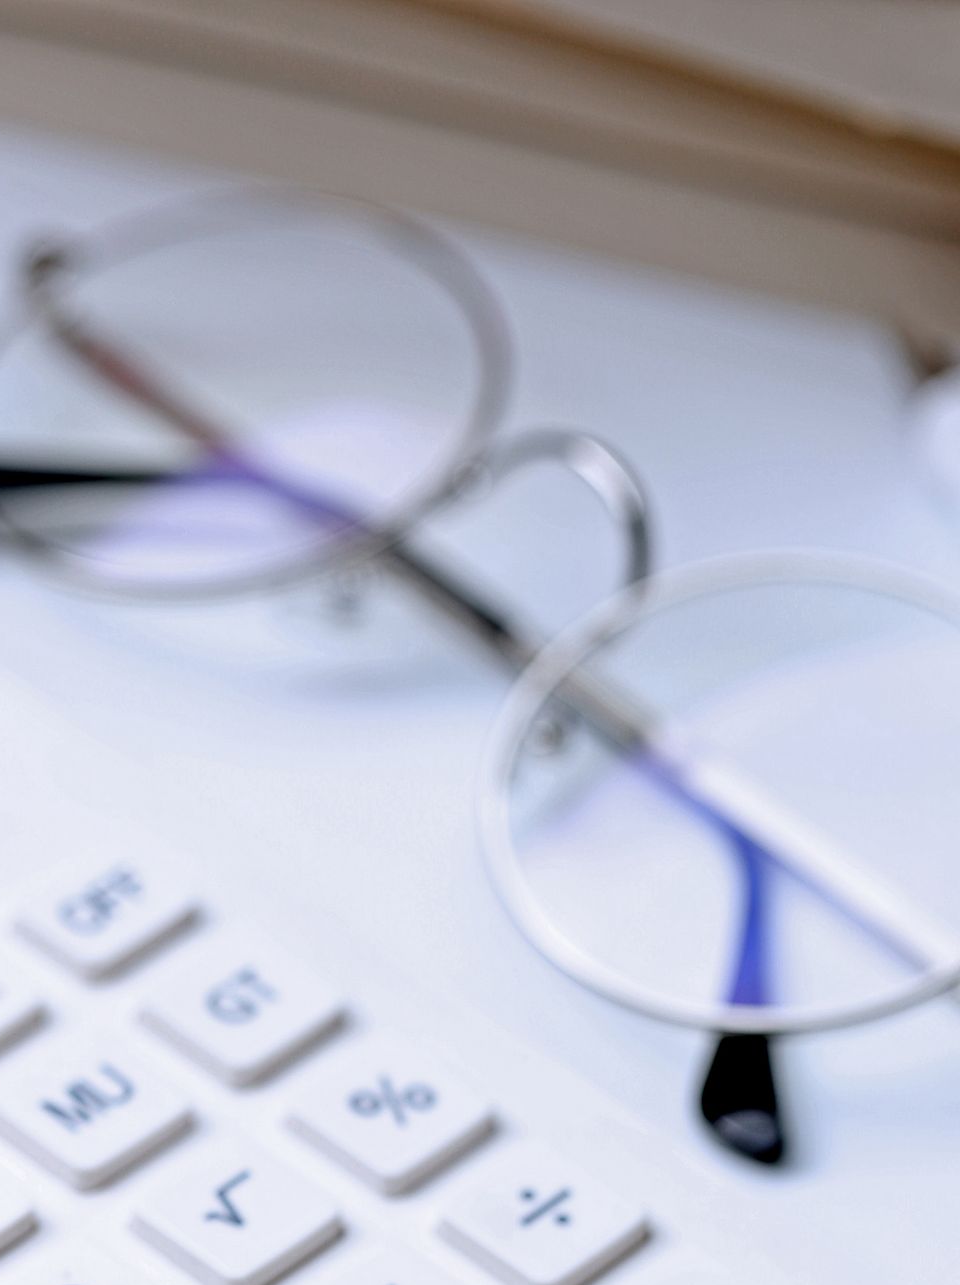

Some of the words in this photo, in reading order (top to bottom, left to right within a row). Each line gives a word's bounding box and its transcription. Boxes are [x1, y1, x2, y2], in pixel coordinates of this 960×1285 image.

[205, 968, 275, 1024] GT
[41, 1066, 134, 1130] MU
[347, 1077, 437, 1125] %
